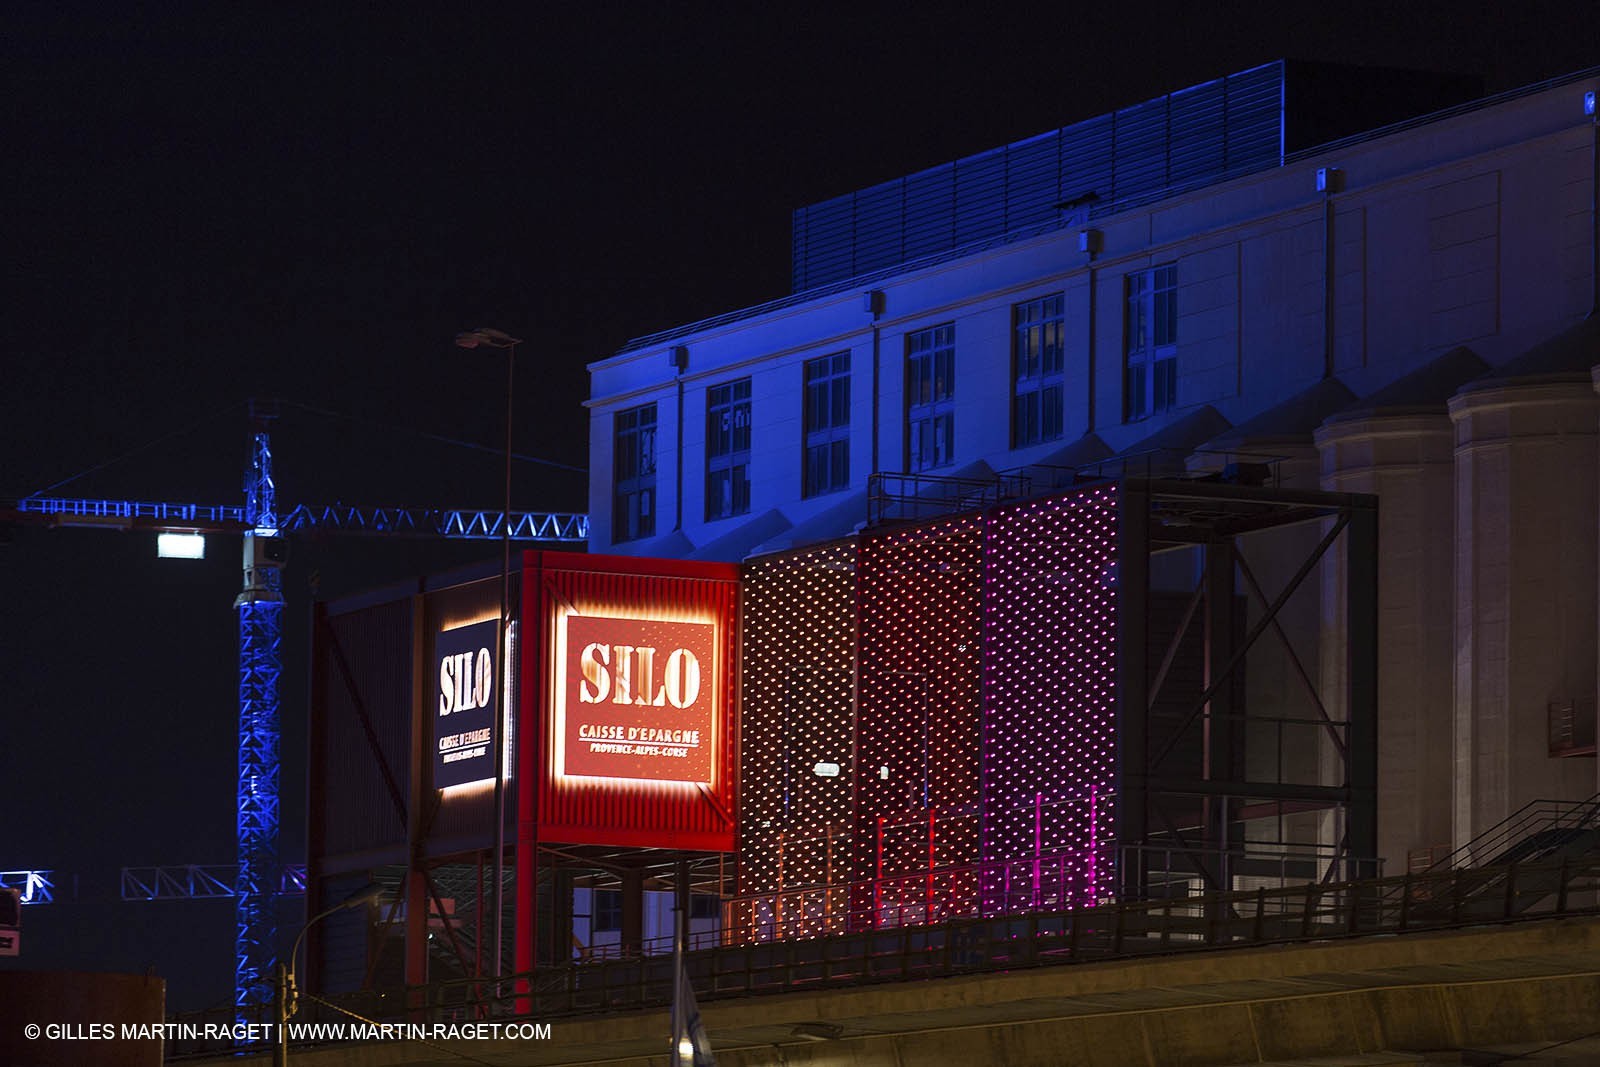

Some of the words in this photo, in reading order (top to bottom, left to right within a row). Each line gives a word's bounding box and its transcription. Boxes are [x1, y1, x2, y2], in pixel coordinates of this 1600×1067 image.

[439, 647, 492, 717] SILO
[580, 642, 700, 709] SILO
[579, 724, 624, 740] CAISSE
[628, 727, 699, 744] D'EPARGNE
[590, 743, 689, 758] PROVENCE-ALPES-CORSE
